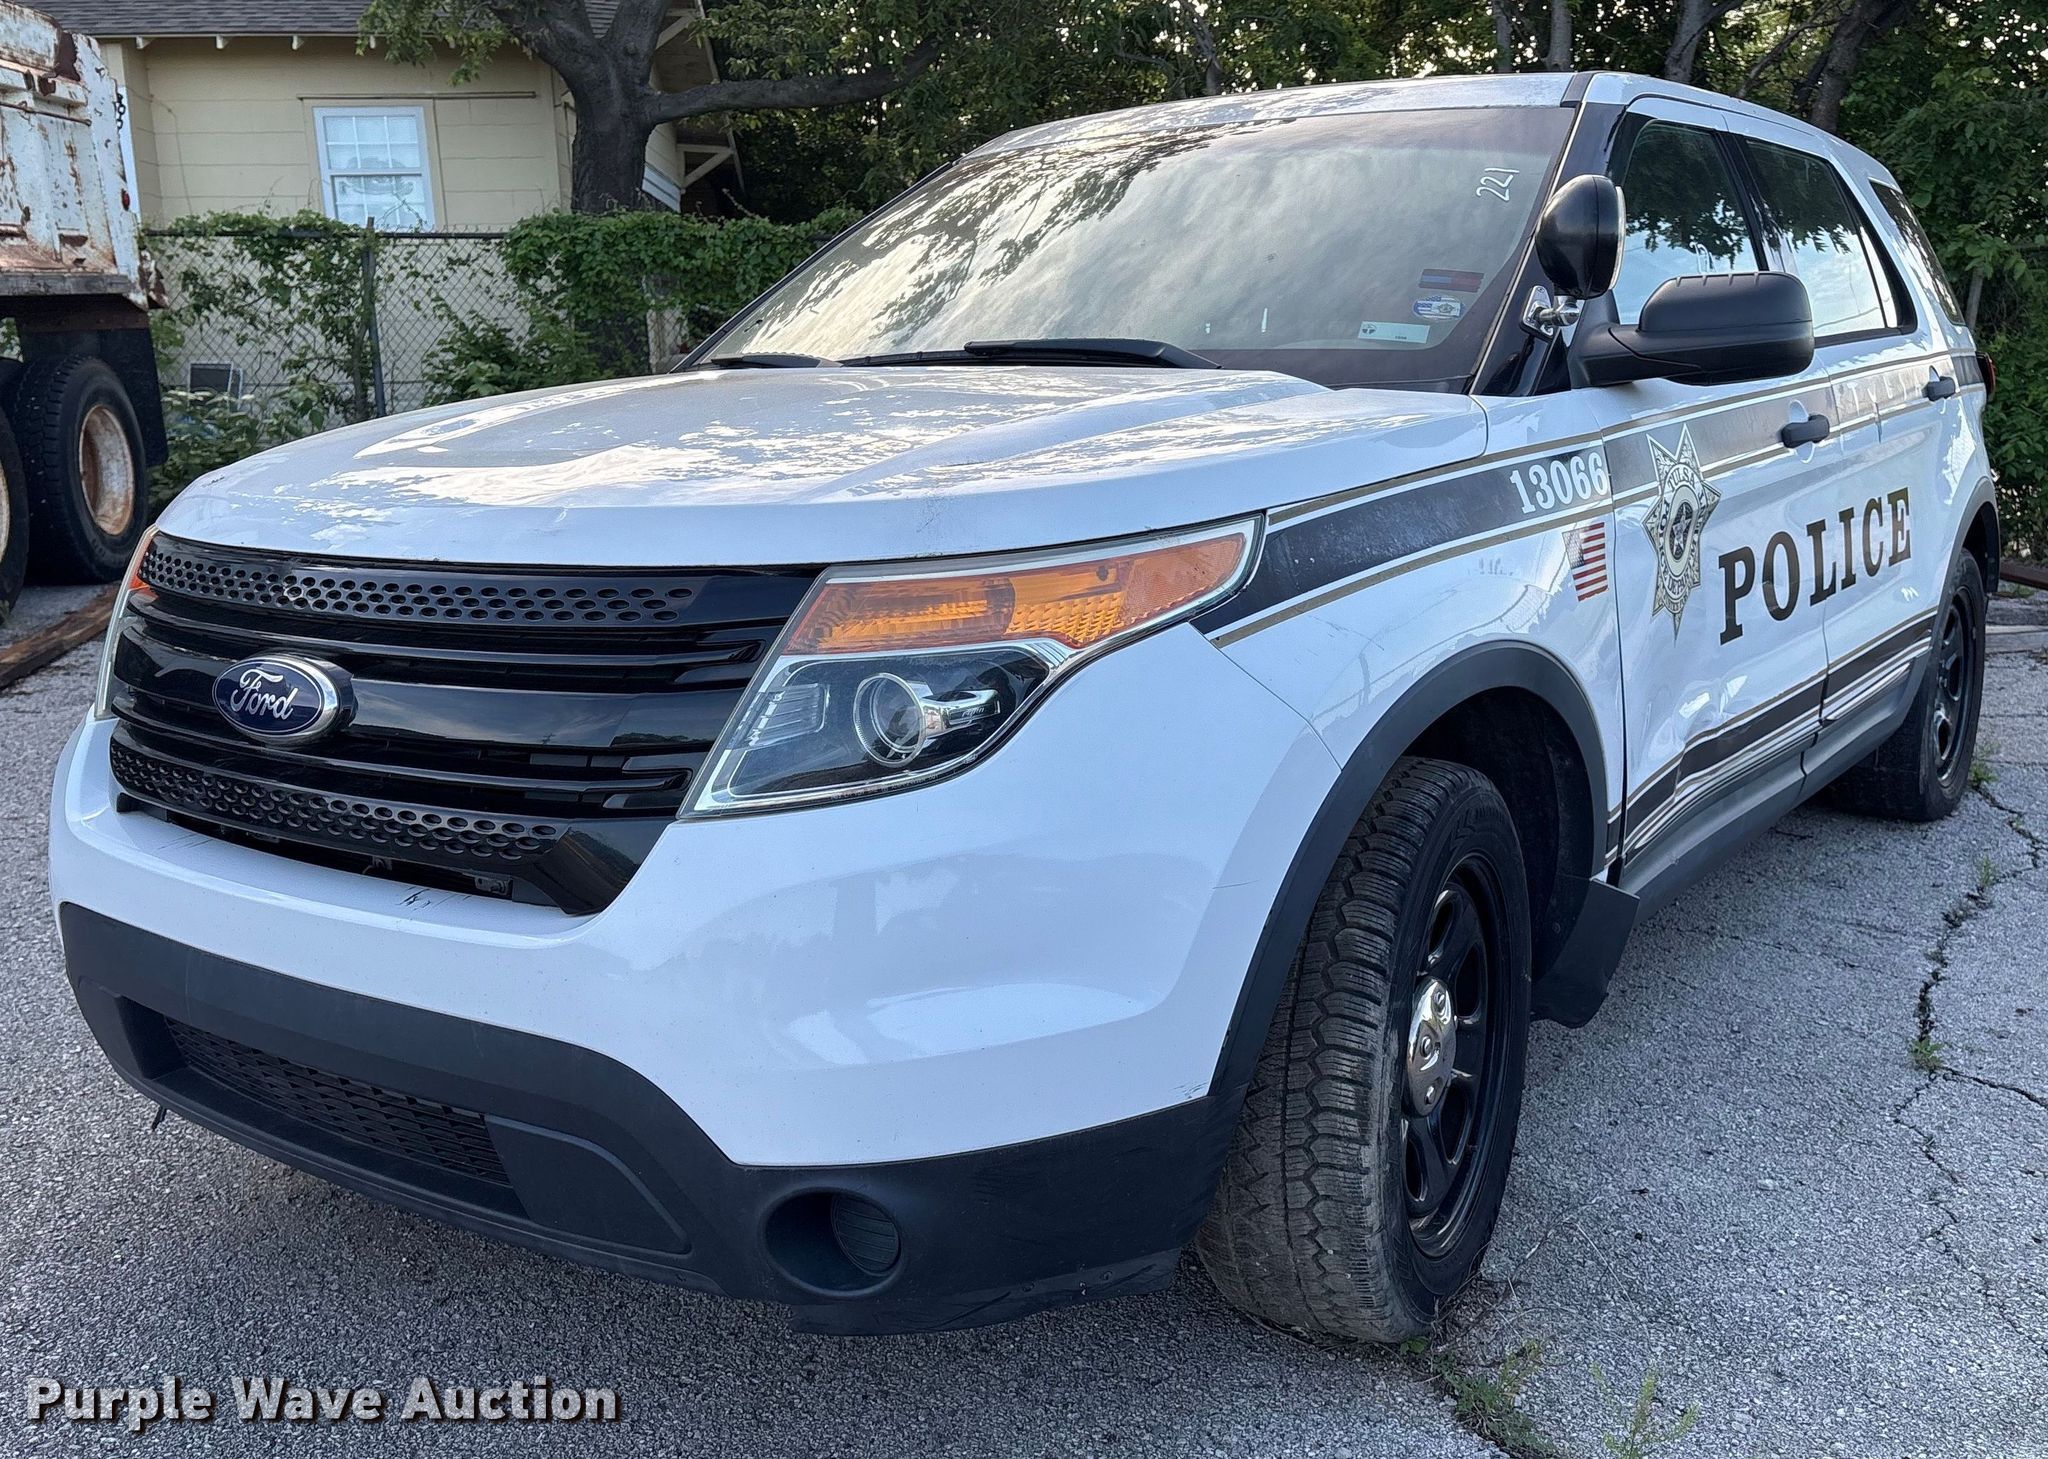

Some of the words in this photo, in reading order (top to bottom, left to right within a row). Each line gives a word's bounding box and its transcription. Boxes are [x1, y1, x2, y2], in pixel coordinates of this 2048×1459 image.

[1475, 167, 1520, 201] 221
[1509, 452, 1608, 514] 13066
[1667, 468, 1696, 492] TULSA
[1718, 487, 1911, 645] POLICE
[230, 669, 298, 720] Ford
